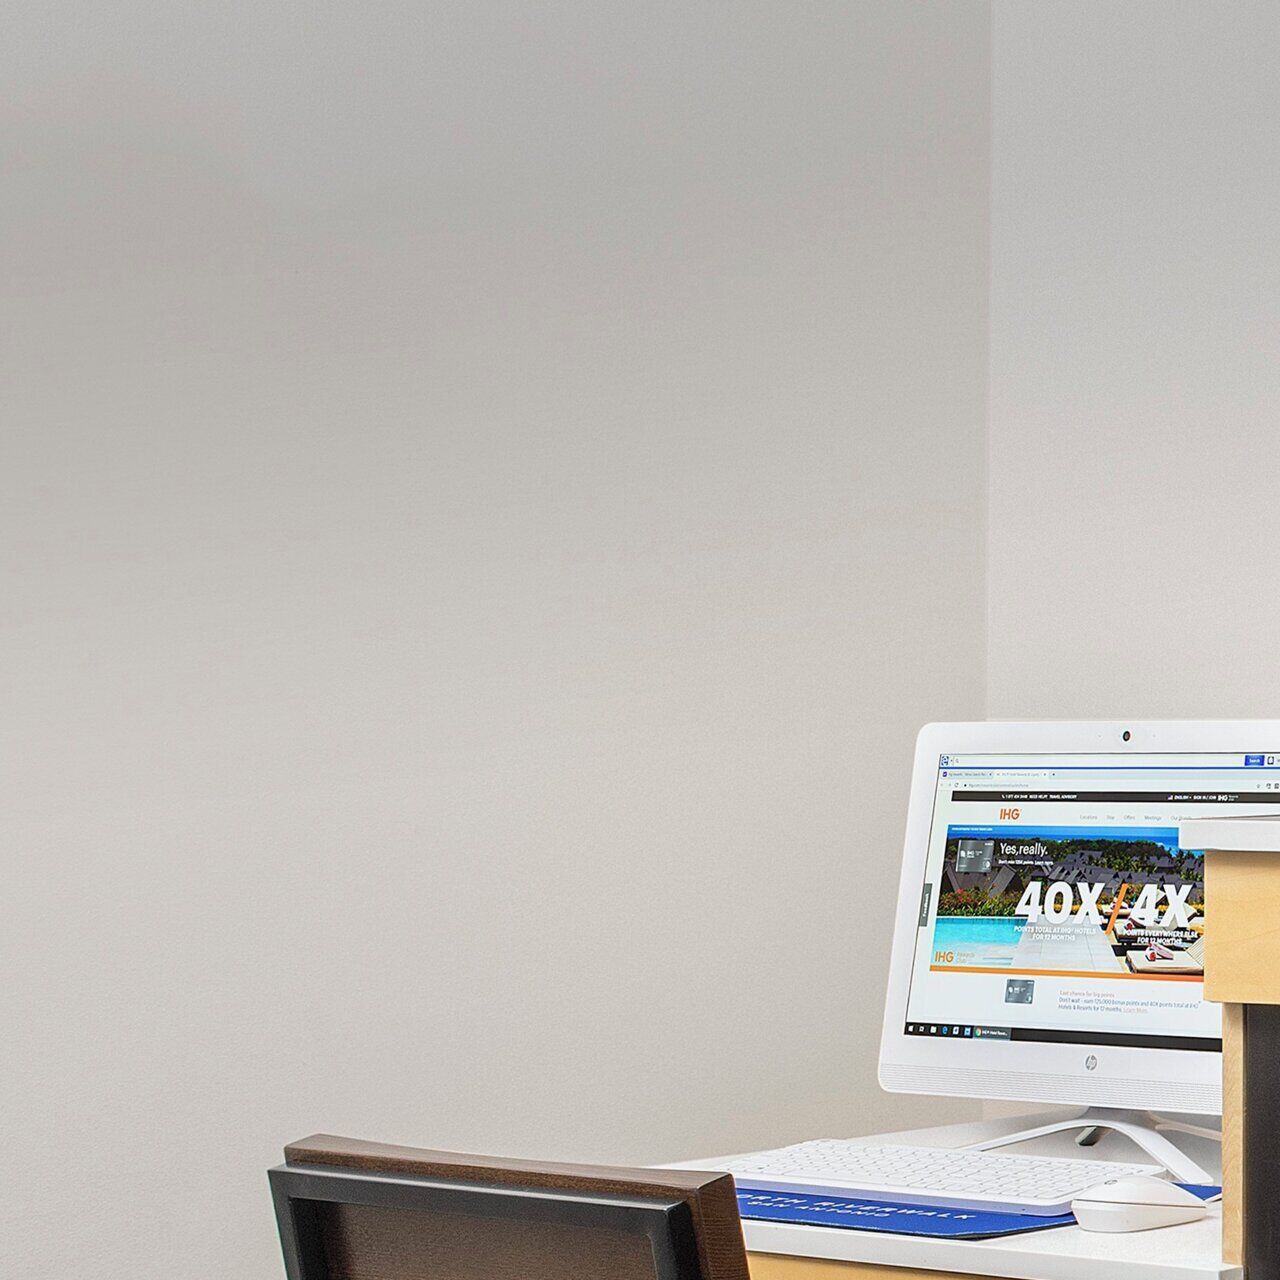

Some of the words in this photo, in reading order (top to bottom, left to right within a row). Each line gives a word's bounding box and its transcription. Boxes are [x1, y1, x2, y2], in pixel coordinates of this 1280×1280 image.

[1000, 808, 1021, 820] IHG
[1000, 843, 1048, 858] Yes,really.
[1014, 882, 1105, 924] 40X
[1130, 884, 1193, 927] 4X
[935, 951, 954, 963] IHG
[736, 1193, 802, 1204] ORTH
[813, 1201, 976, 1220] RIVERWALK
[747, 1201, 787, 1209] SAN
[795, 1205, 890, 1217] ANTONIO
